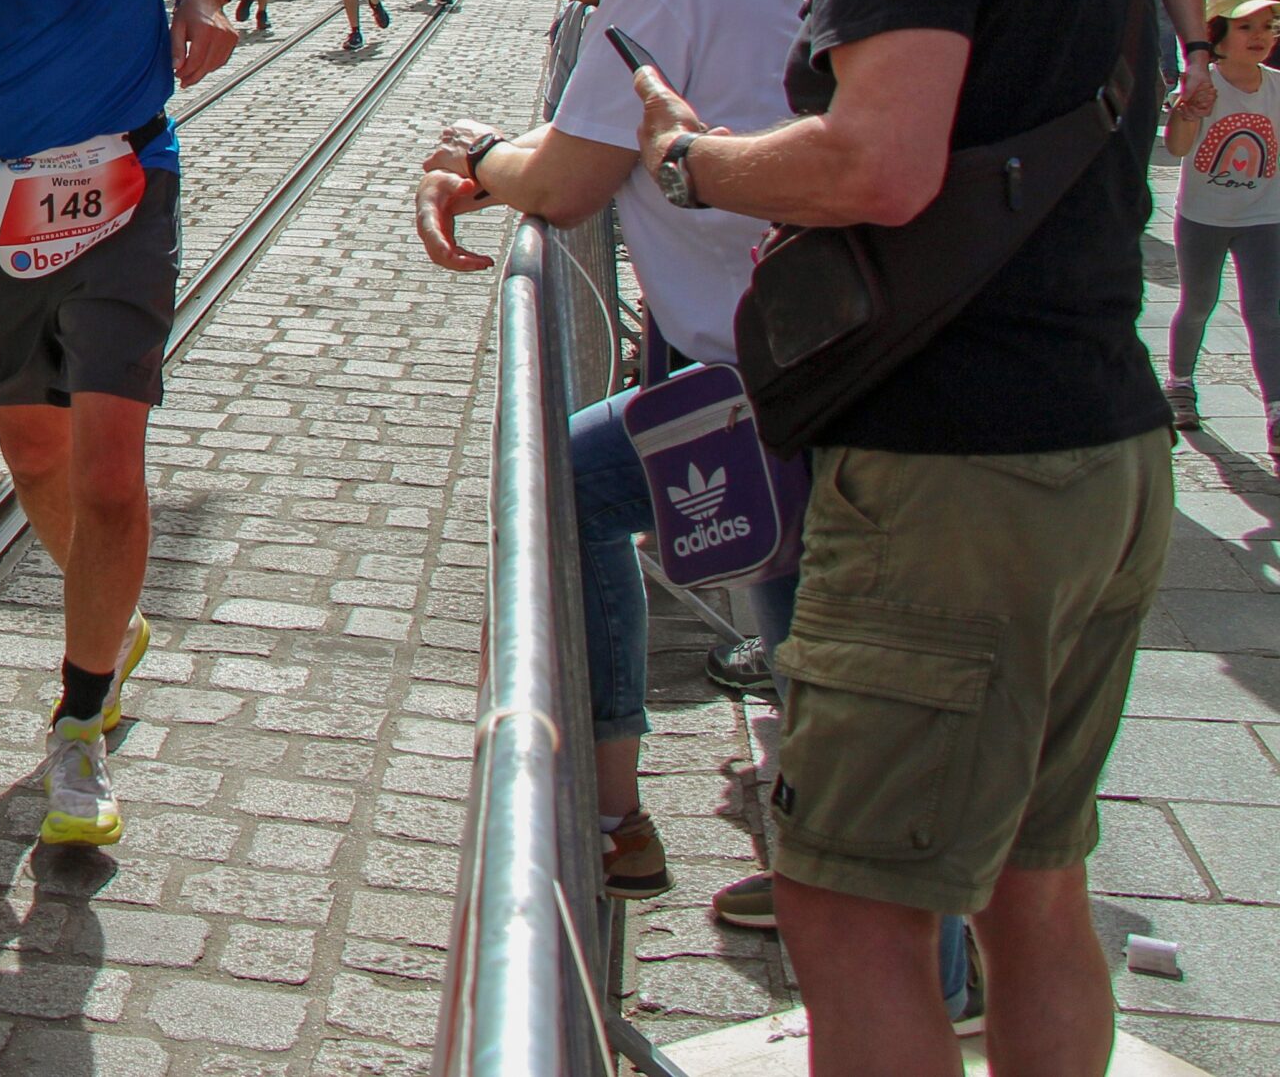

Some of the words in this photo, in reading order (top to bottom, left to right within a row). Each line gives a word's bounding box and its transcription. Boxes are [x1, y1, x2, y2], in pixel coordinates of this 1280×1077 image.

[52, 177, 91, 187] Werner
[1207, 170, 1256, 189] Love
[40, 189, 102, 223] 148
[31, 232, 69, 242] OBERBANK
[71, 223, 106, 236] MARATH
[674, 516, 751, 557] adidas
